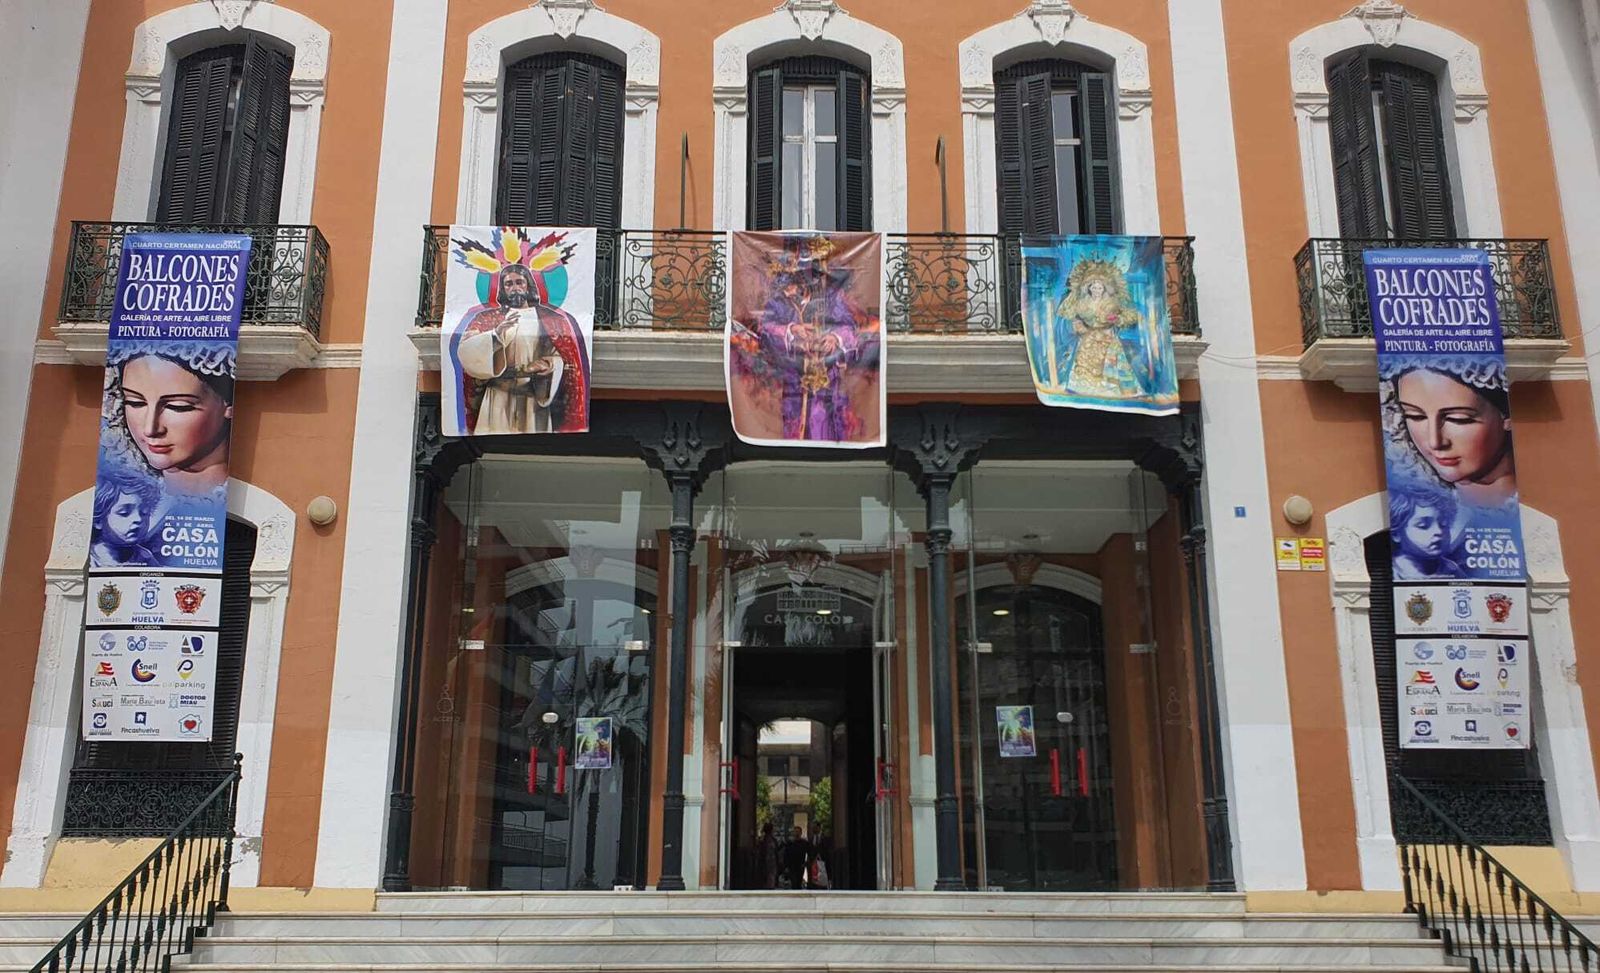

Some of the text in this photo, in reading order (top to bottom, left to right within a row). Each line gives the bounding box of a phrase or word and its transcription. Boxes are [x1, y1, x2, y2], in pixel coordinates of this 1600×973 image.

[126, 254, 239, 282] BALCONES
[1374, 268, 1486, 296] BALCONES
[123, 283, 235, 312] COFRADES
[1380, 298, 1490, 326] COFRADES
[118, 325, 160, 337] PINTURA
[169, 324, 229, 337] FOTOGRAFÍA
[1383, 328, 1413, 336] GALERÍA
[1385, 340, 1428, 351] PINTURA
[1435, 338, 1495, 352] FOTOGRAFÍA
[162, 527, 218, 543] CASA
[161, 543, 218, 558] COLÓN
[1465, 539, 1518, 554] CASA
[1466, 554, 1520, 568] COLÓN
